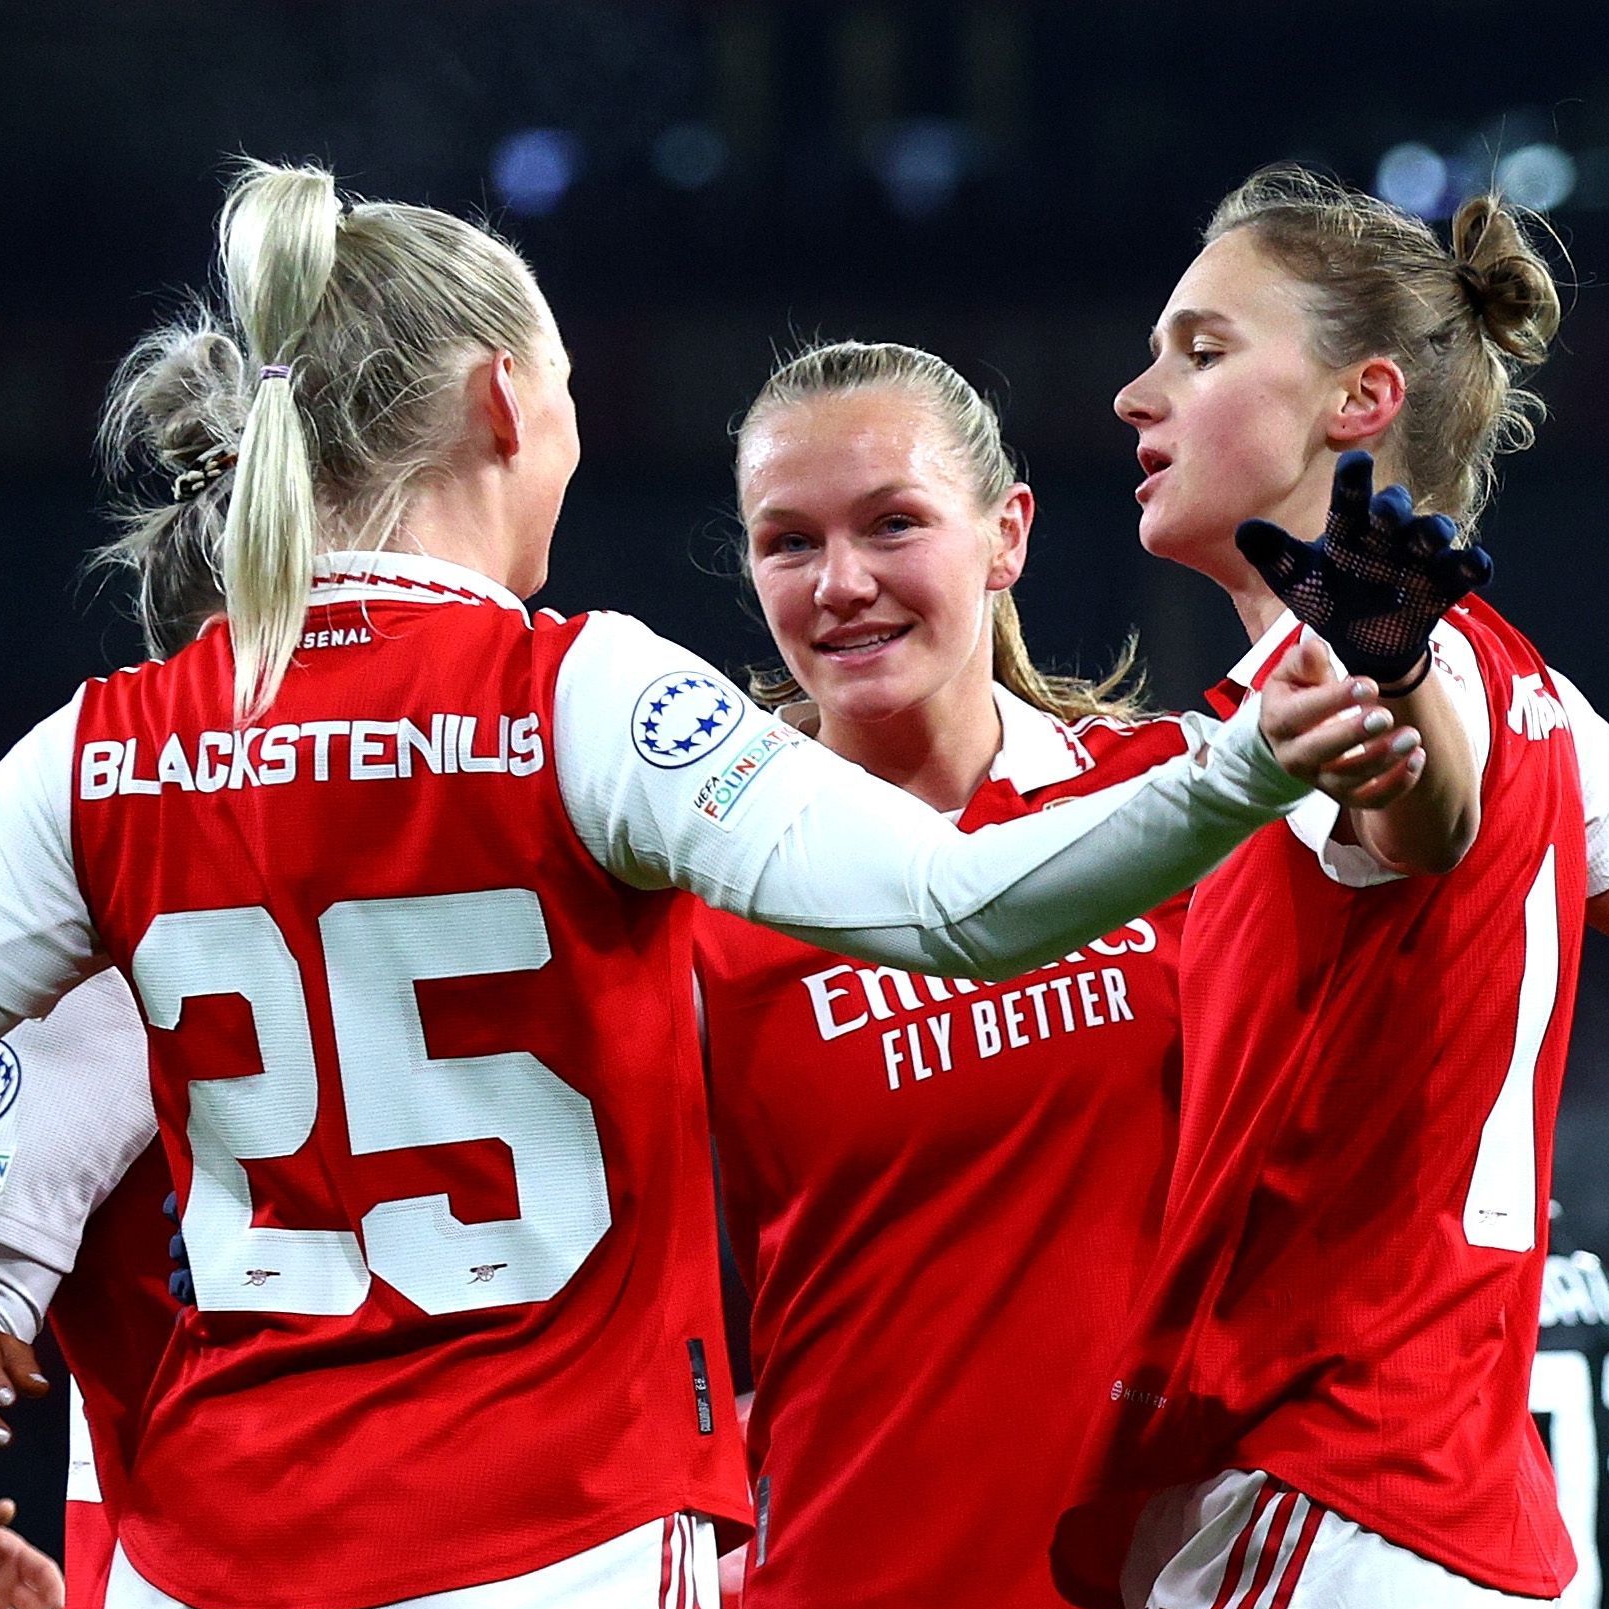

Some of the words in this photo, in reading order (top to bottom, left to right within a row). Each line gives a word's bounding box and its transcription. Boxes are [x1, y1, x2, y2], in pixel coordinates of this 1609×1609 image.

[79, 711, 545, 801] BLACKSTENIUS
[693, 776, 721, 809] UEFA
[880, 1012, 953, 1091] FLY
[970, 966, 1135, 1060] BETTER
[131, 887, 613, 1317] 25
